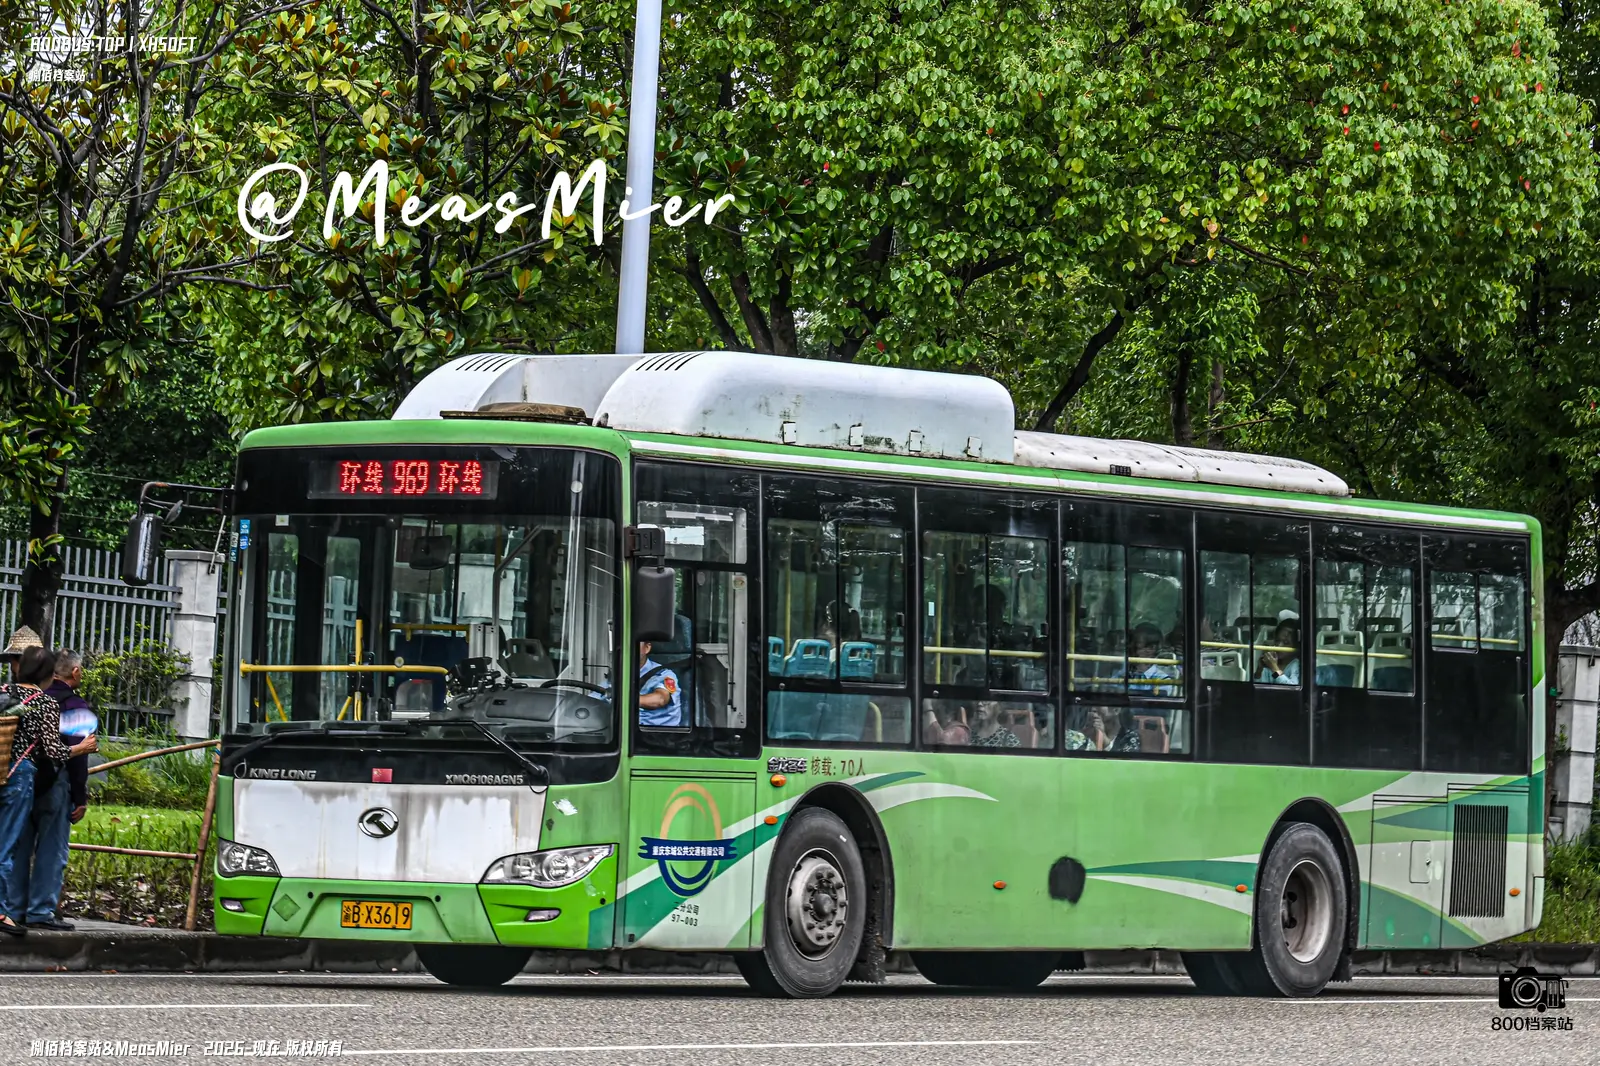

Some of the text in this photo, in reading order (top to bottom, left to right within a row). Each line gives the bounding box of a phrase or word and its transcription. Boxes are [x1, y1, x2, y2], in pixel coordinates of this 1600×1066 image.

[341, 461, 482, 494] 环线 969 环线
[767, 756, 808, 773] 金龙客车
[249, 767, 317, 780] KING LONG
[671, 913, 699, 927] 97-003
